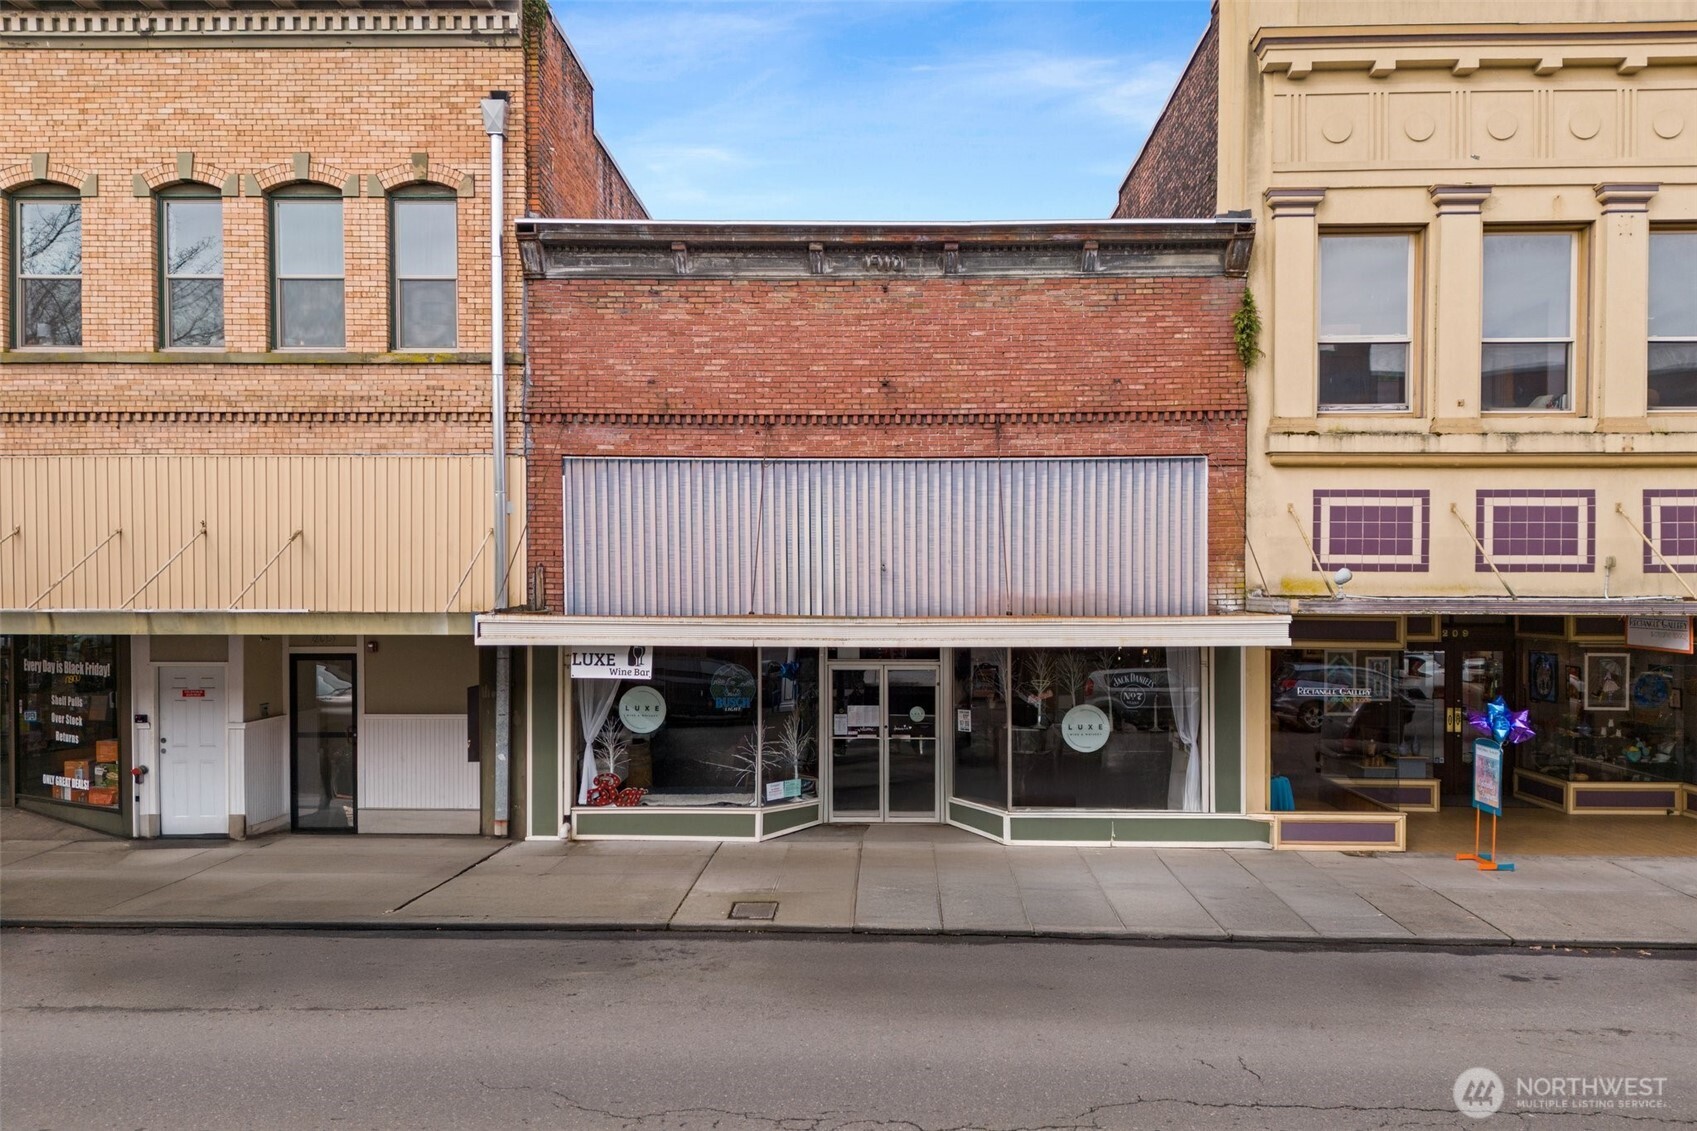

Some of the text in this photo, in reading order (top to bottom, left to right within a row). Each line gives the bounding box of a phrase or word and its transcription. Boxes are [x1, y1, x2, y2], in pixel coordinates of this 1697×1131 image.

[1442, 629, 1469, 638] 209
[572, 653, 616, 667] LUXE
[23, 658, 111, 678] Every Day is Black Friday!
[609, 668, 650, 677] Wine Bar
[1297, 686, 1372, 697] RECTANGLE GALLERY
[51, 694, 84, 708] Shelf Pulls
[715, 697, 752, 709] BUSCH
[51, 712, 83, 727] Over Stock
[1068, 723, 1103, 731] LUXE
[55, 730, 80, 745] Returns
[42, 774, 90, 791] ONLY GREAT DEALS!
